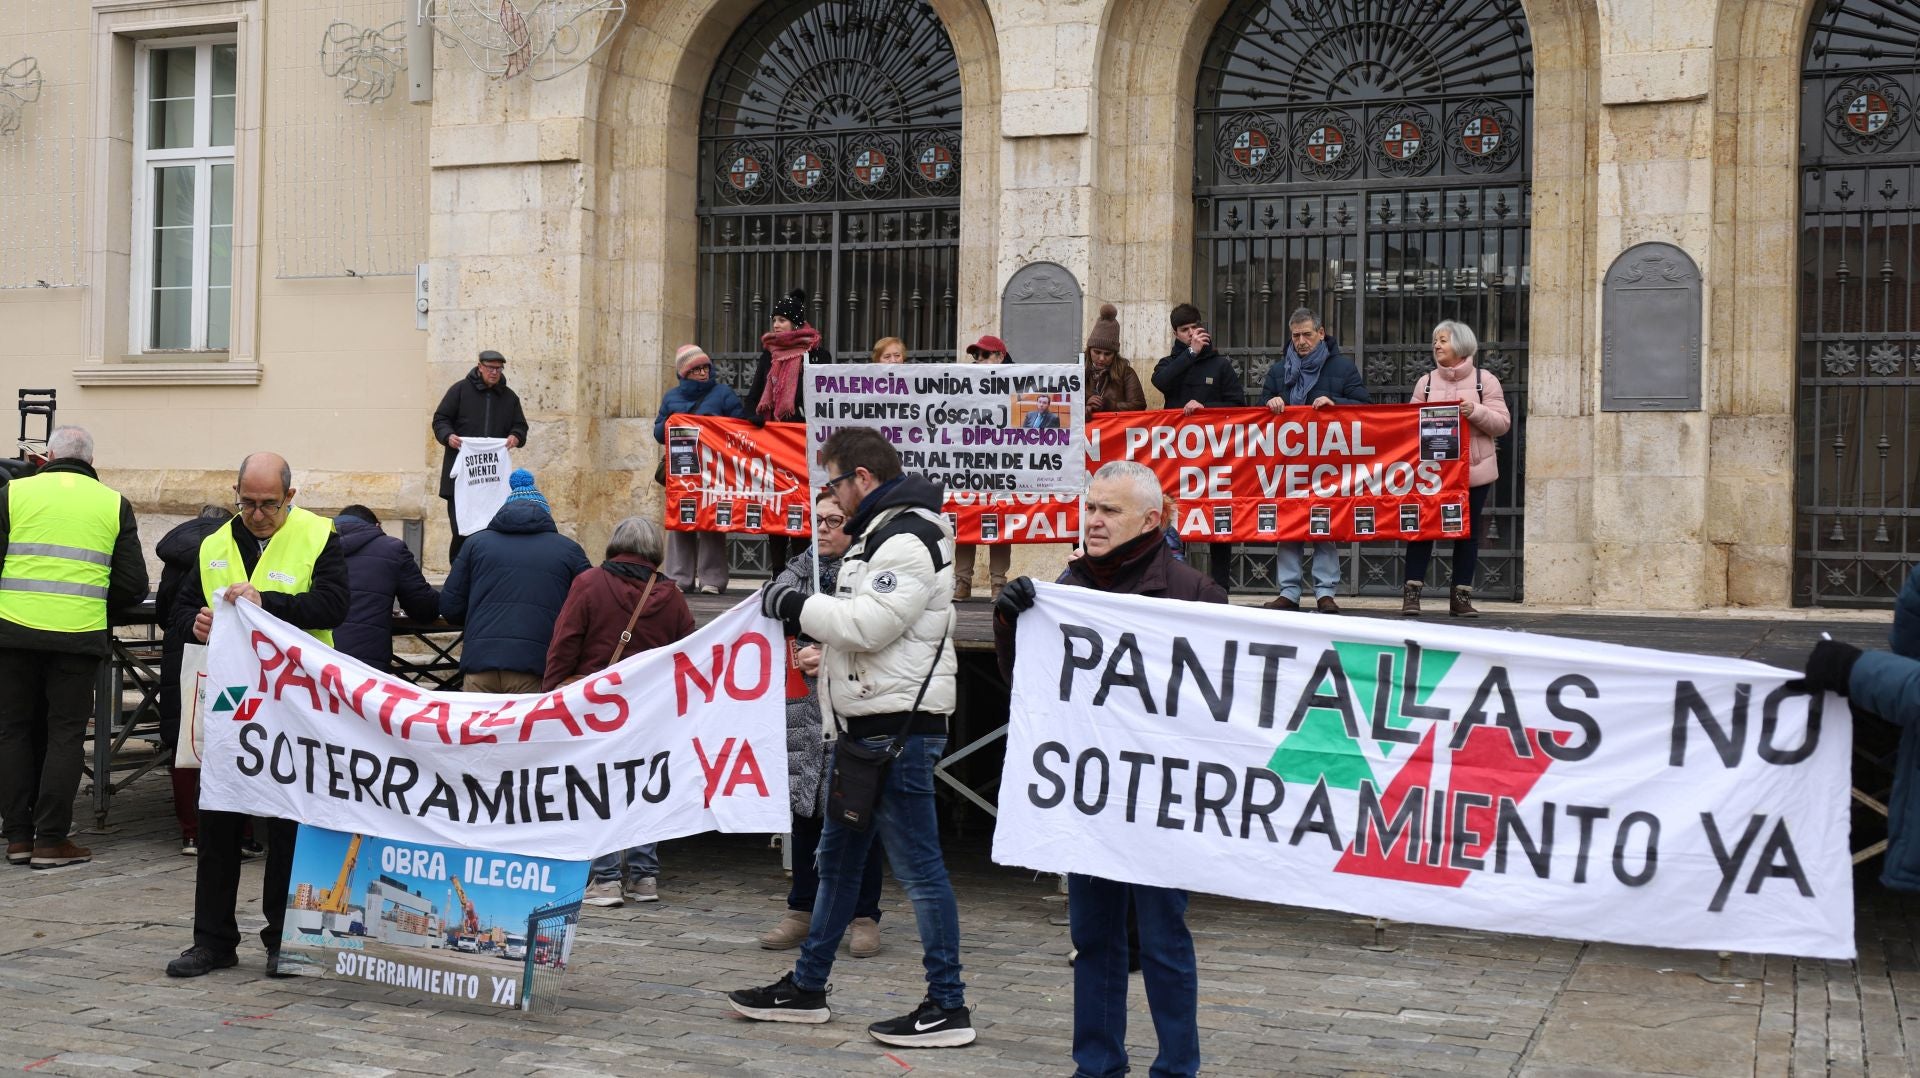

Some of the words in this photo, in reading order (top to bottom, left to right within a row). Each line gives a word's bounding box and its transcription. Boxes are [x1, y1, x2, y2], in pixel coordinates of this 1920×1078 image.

[1013, 375, 1081, 394] VALLAS
[839, 402, 921, 420] PUENTES
[880, 426, 903, 444] DE
[927, 427, 939, 444] Y
[1125, 420, 1376, 462] PROVINCIAL
[465, 453, 498, 467] SOTERRA
[468, 465, 497, 478] MIENTO
[928, 451, 951, 468] AL
[952, 451, 998, 470] TREN
[1001, 452, 1024, 470] DE
[1029, 453, 1063, 471] LAS
[1179, 465, 1233, 500] DE
[1256, 461, 1442, 499] VECINOS
[251, 630, 630, 745] PANTALLAS
[673, 631, 772, 717] NO
[1058, 622, 1603, 762] PANTALLAS
[1669, 678, 1823, 769] NO
[236, 722, 671, 825] SOTERRAMIENTO
[691, 736, 770, 809] YA
[1027, 740, 1661, 888] SOTERRAMIENTO
[1701, 811, 1815, 913] YA
[381, 845, 447, 881] OBRA
[464, 856, 556, 893] ILEGAL
[335, 951, 479, 999] SOTERRAMIENTO
[491, 976, 517, 1006] YA
